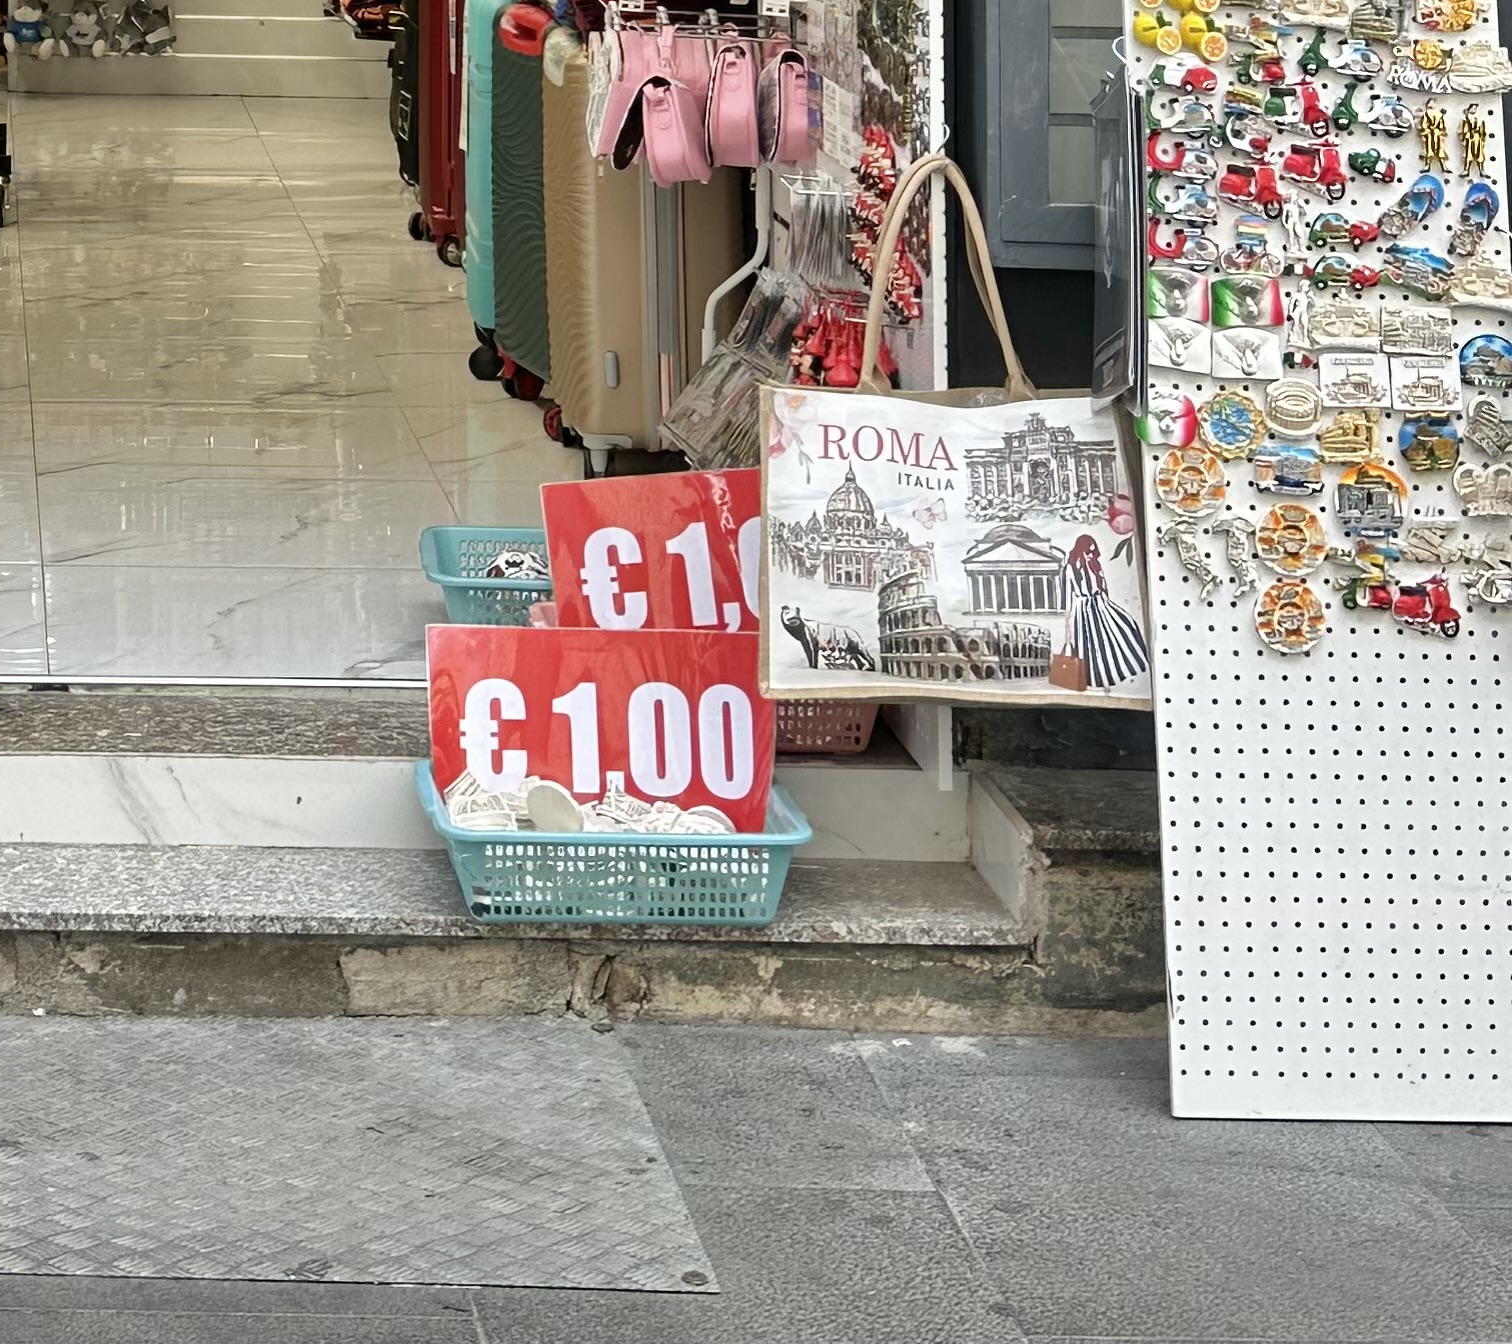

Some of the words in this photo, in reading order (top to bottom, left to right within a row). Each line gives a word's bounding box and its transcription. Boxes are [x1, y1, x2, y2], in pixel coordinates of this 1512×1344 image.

[818, 424, 959, 472] ROMA
[897, 471, 955, 491] ITALIA
[580, 527, 648, 630] €
[459, 678, 527, 794] €
